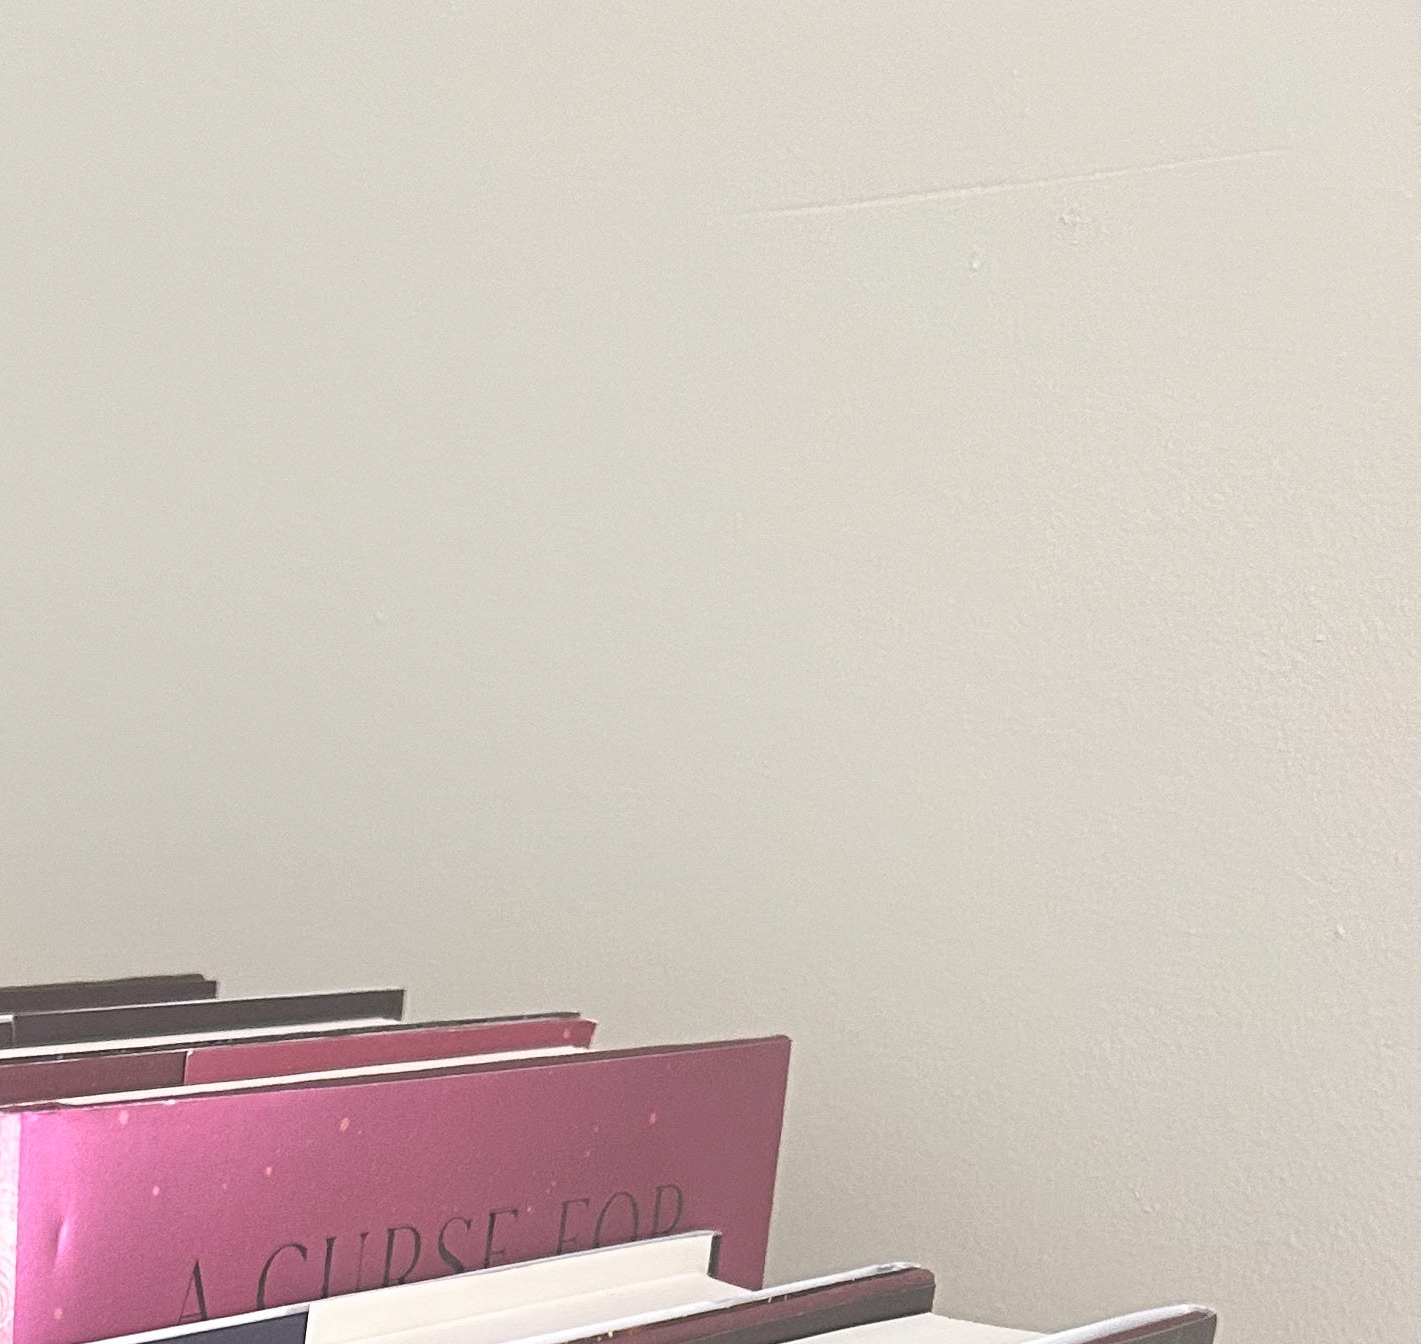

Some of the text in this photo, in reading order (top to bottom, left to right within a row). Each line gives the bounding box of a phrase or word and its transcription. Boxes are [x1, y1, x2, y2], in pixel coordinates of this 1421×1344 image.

[179, 1183, 684, 1321] A CURSE FOR
